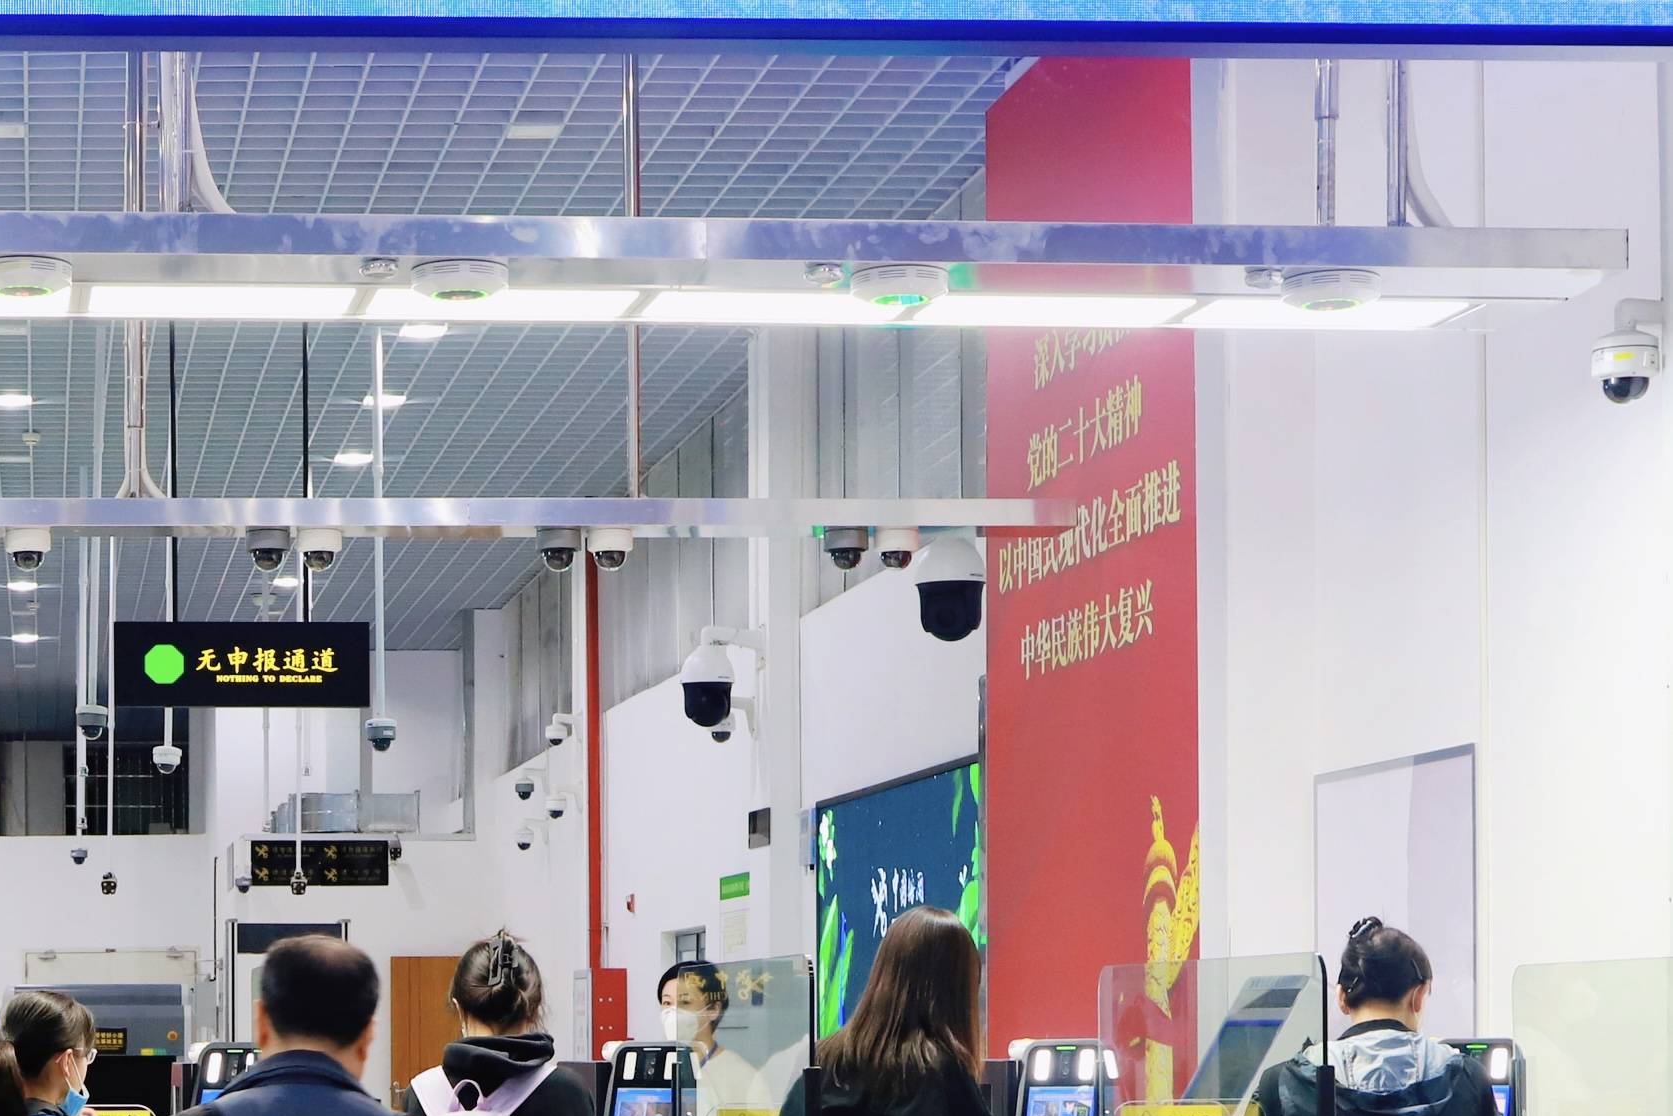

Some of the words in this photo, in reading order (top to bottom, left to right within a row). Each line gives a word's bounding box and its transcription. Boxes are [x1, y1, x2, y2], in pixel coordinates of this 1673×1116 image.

[1027, 374, 1142, 491] 党的二十大精神
[195, 646, 339, 674] 无申报通道
[1021, 578, 1154, 680] 中华民族伟大复兴
[216, 674, 259, 683] NOTHING
[263, 674, 276, 683] TO
[279, 674, 323, 683] DECLARE
